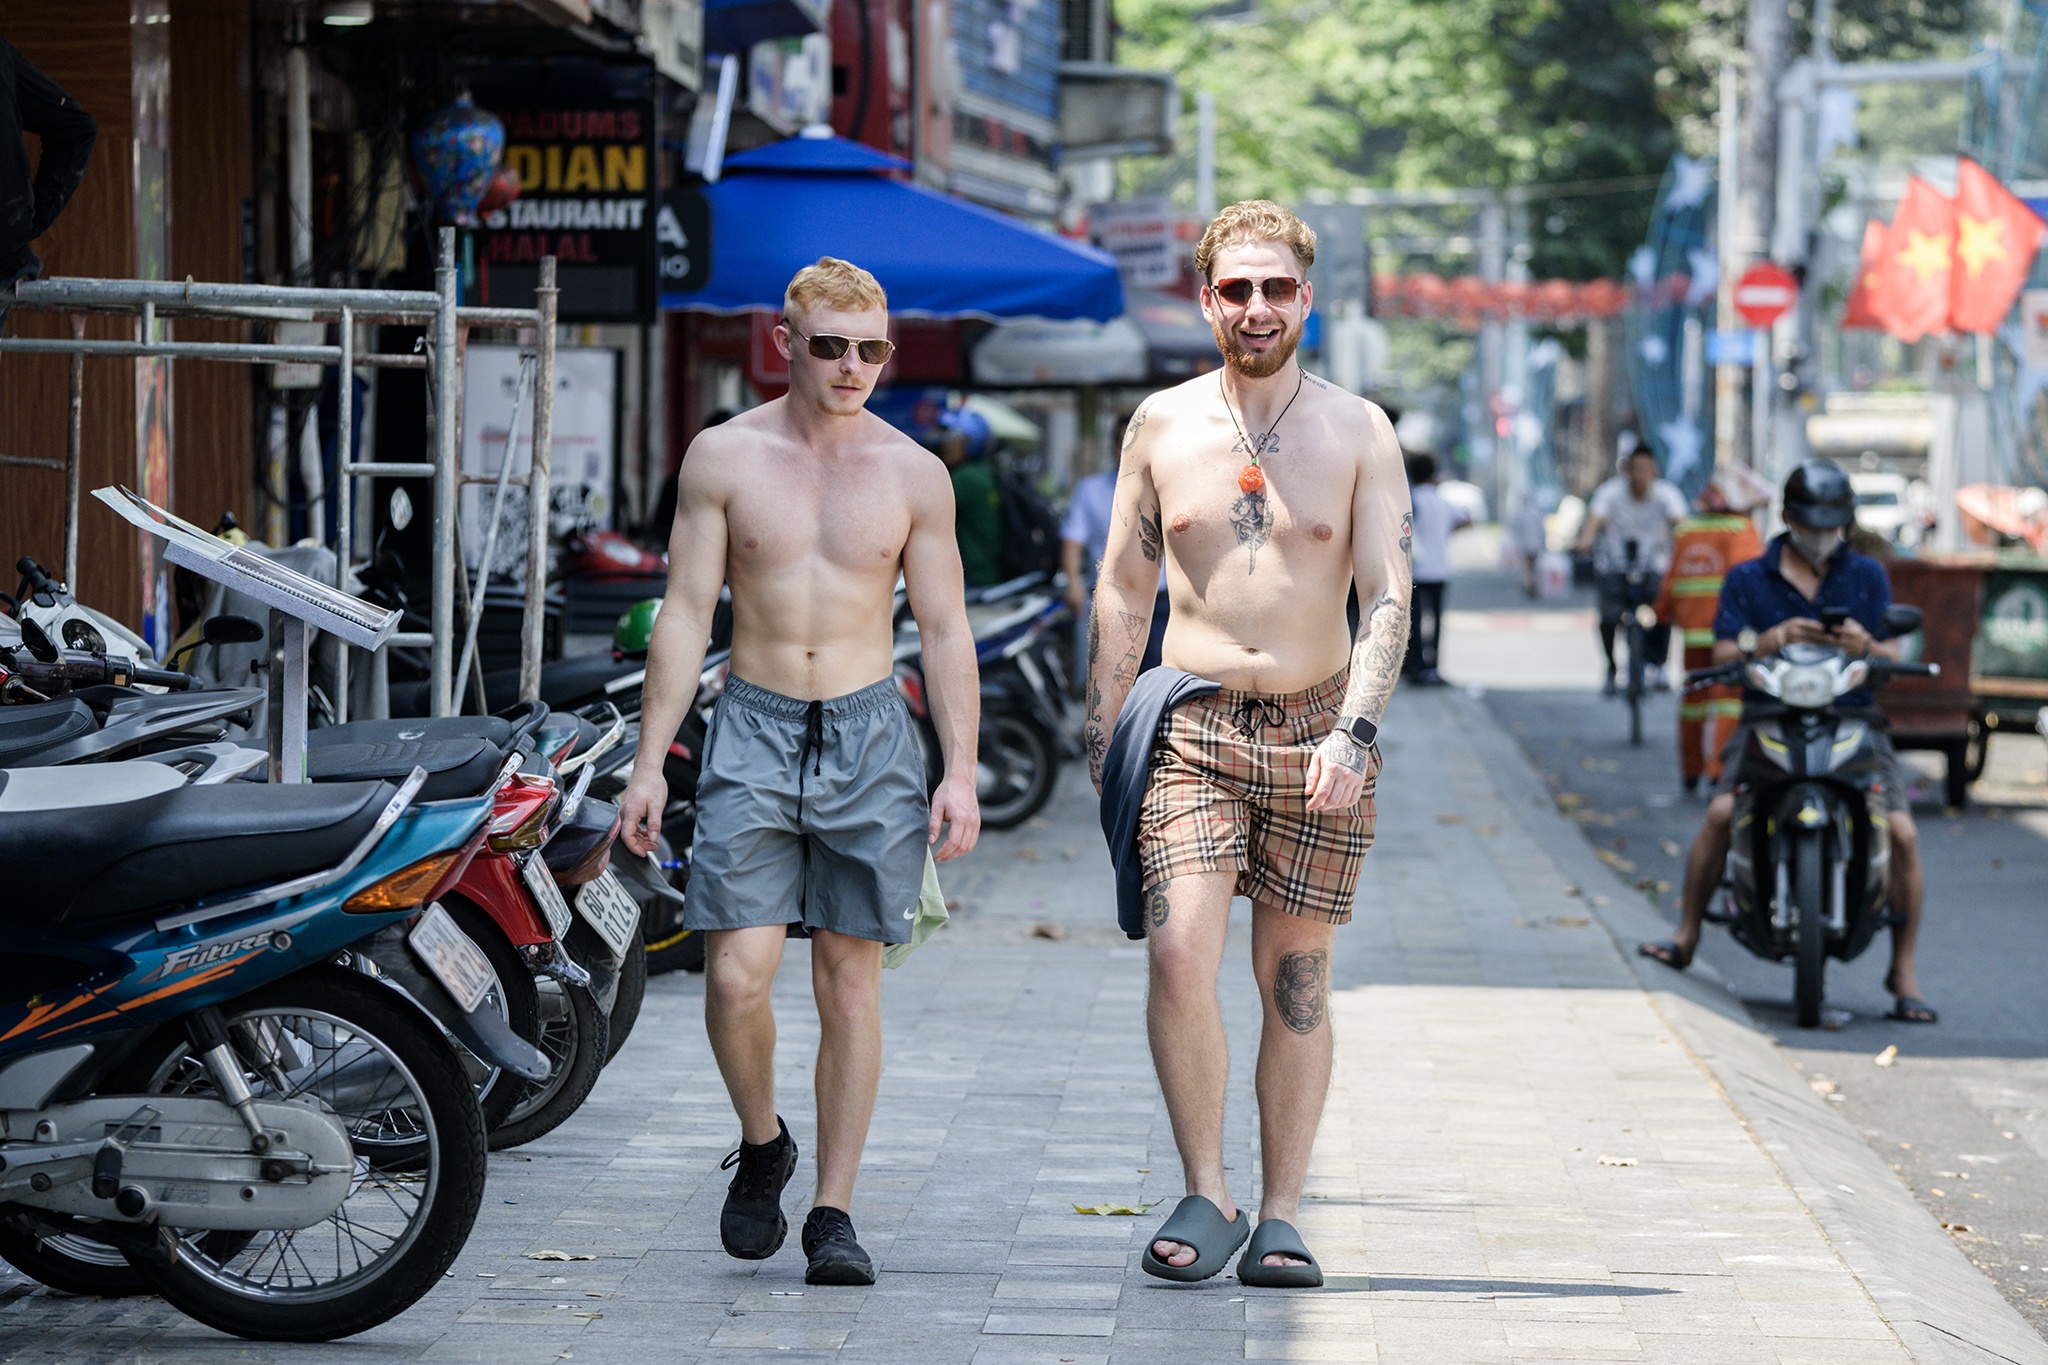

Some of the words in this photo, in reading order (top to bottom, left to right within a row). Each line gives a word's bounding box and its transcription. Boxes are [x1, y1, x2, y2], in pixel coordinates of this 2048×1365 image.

[489, 232, 600, 263] HALAL
[1231, 432, 1281, 453] 2002
[603, 891, 634, 946] 0124
